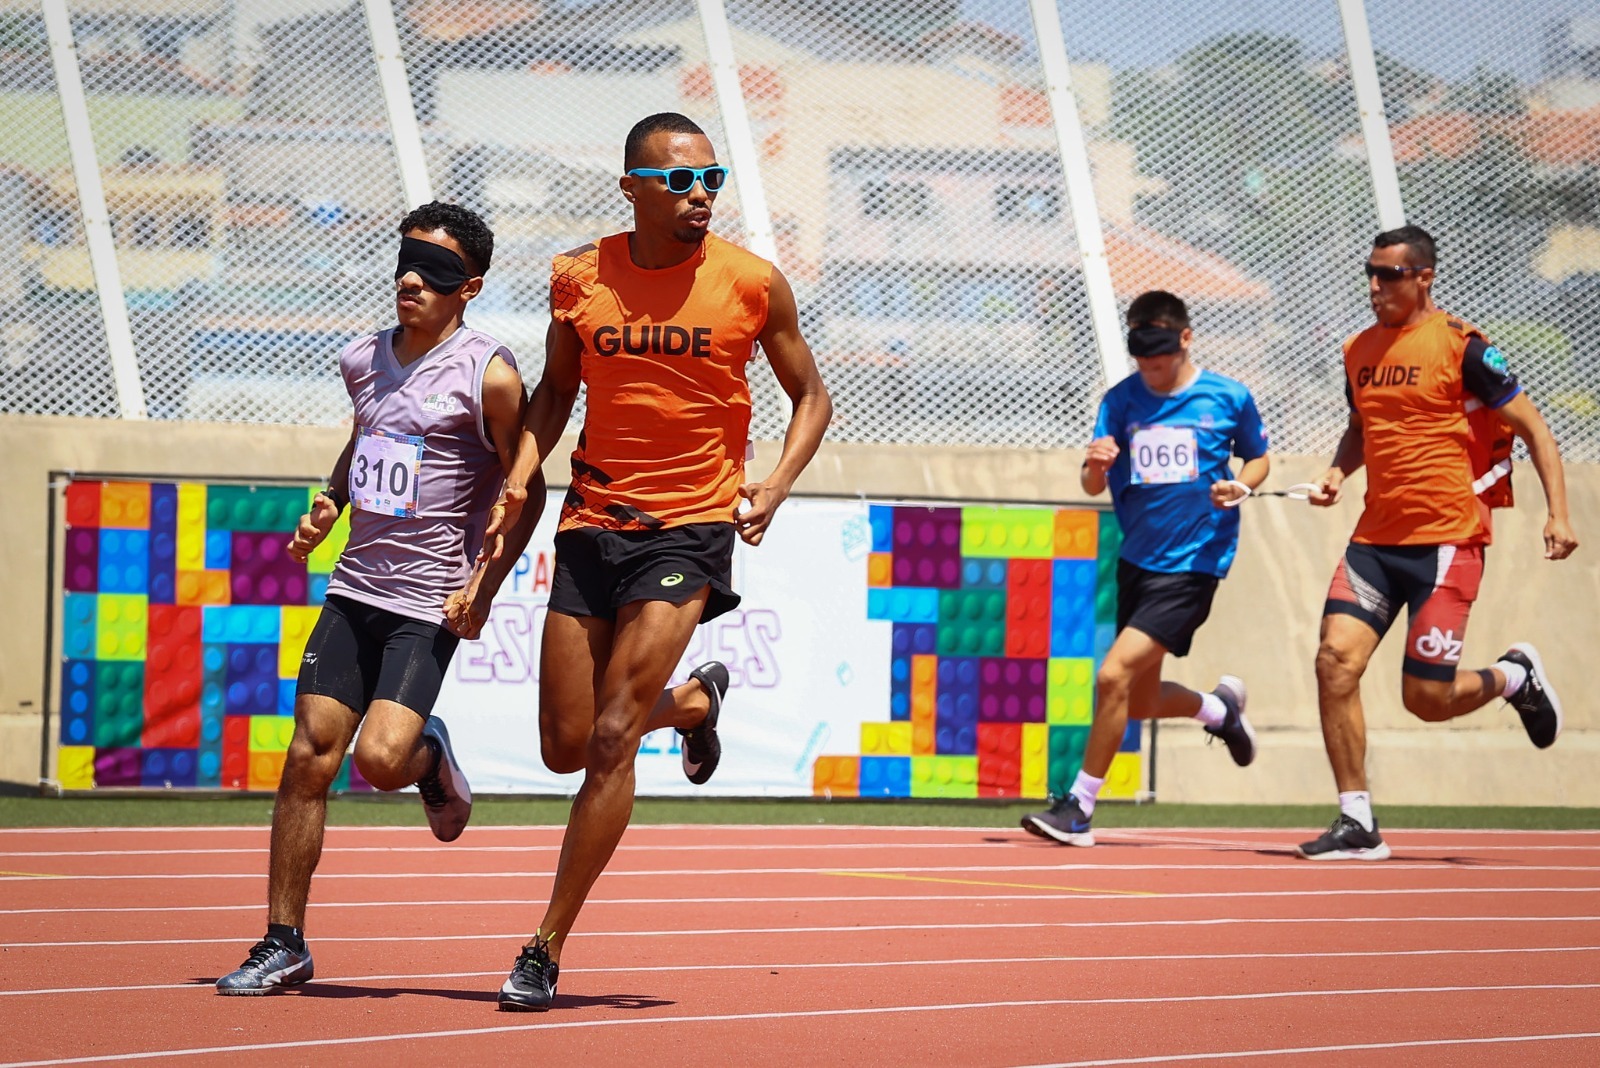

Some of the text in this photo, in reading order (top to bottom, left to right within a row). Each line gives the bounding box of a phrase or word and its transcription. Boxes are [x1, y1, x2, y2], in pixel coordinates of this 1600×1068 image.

[593, 325, 712, 357] GUIDE
[1357, 365, 1421, 388] GUIDE
[1139, 443, 1188, 467] 066
[354, 454, 408, 496] 310
